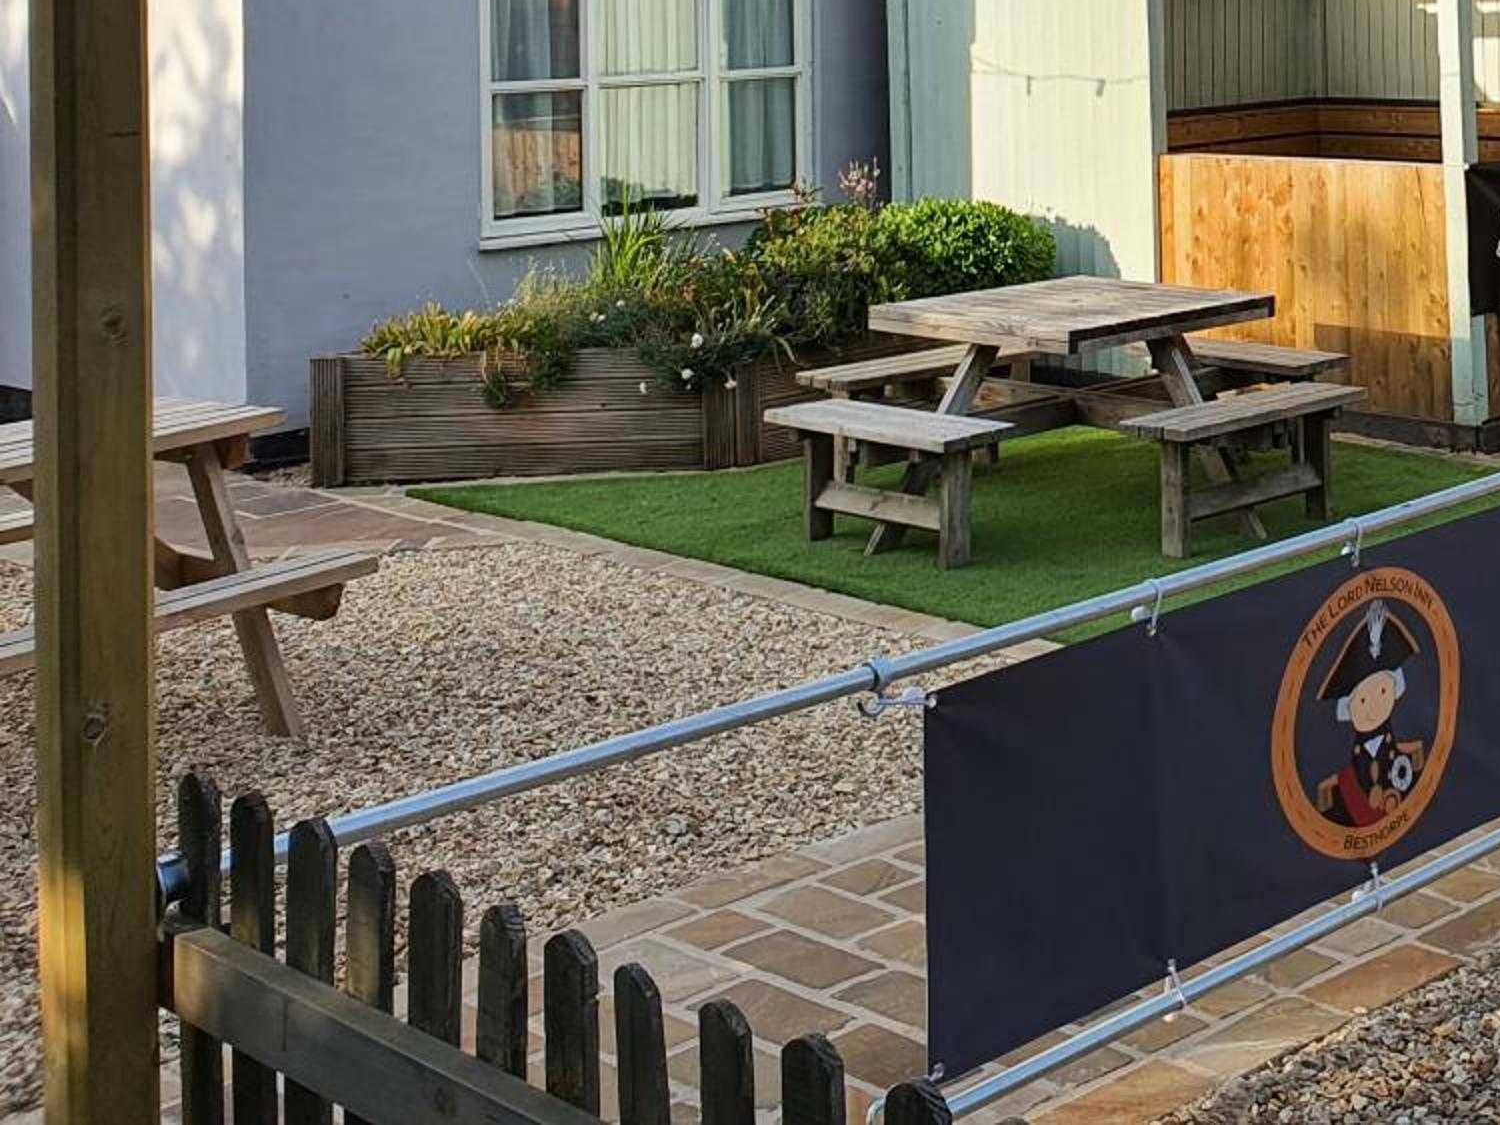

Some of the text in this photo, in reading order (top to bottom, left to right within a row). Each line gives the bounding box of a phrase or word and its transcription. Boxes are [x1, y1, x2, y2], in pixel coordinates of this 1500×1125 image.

[1301, 616, 1330, 649] THE
[1327, 584, 1364, 618] LORD
[1364, 576, 1412, 596] NELSON
